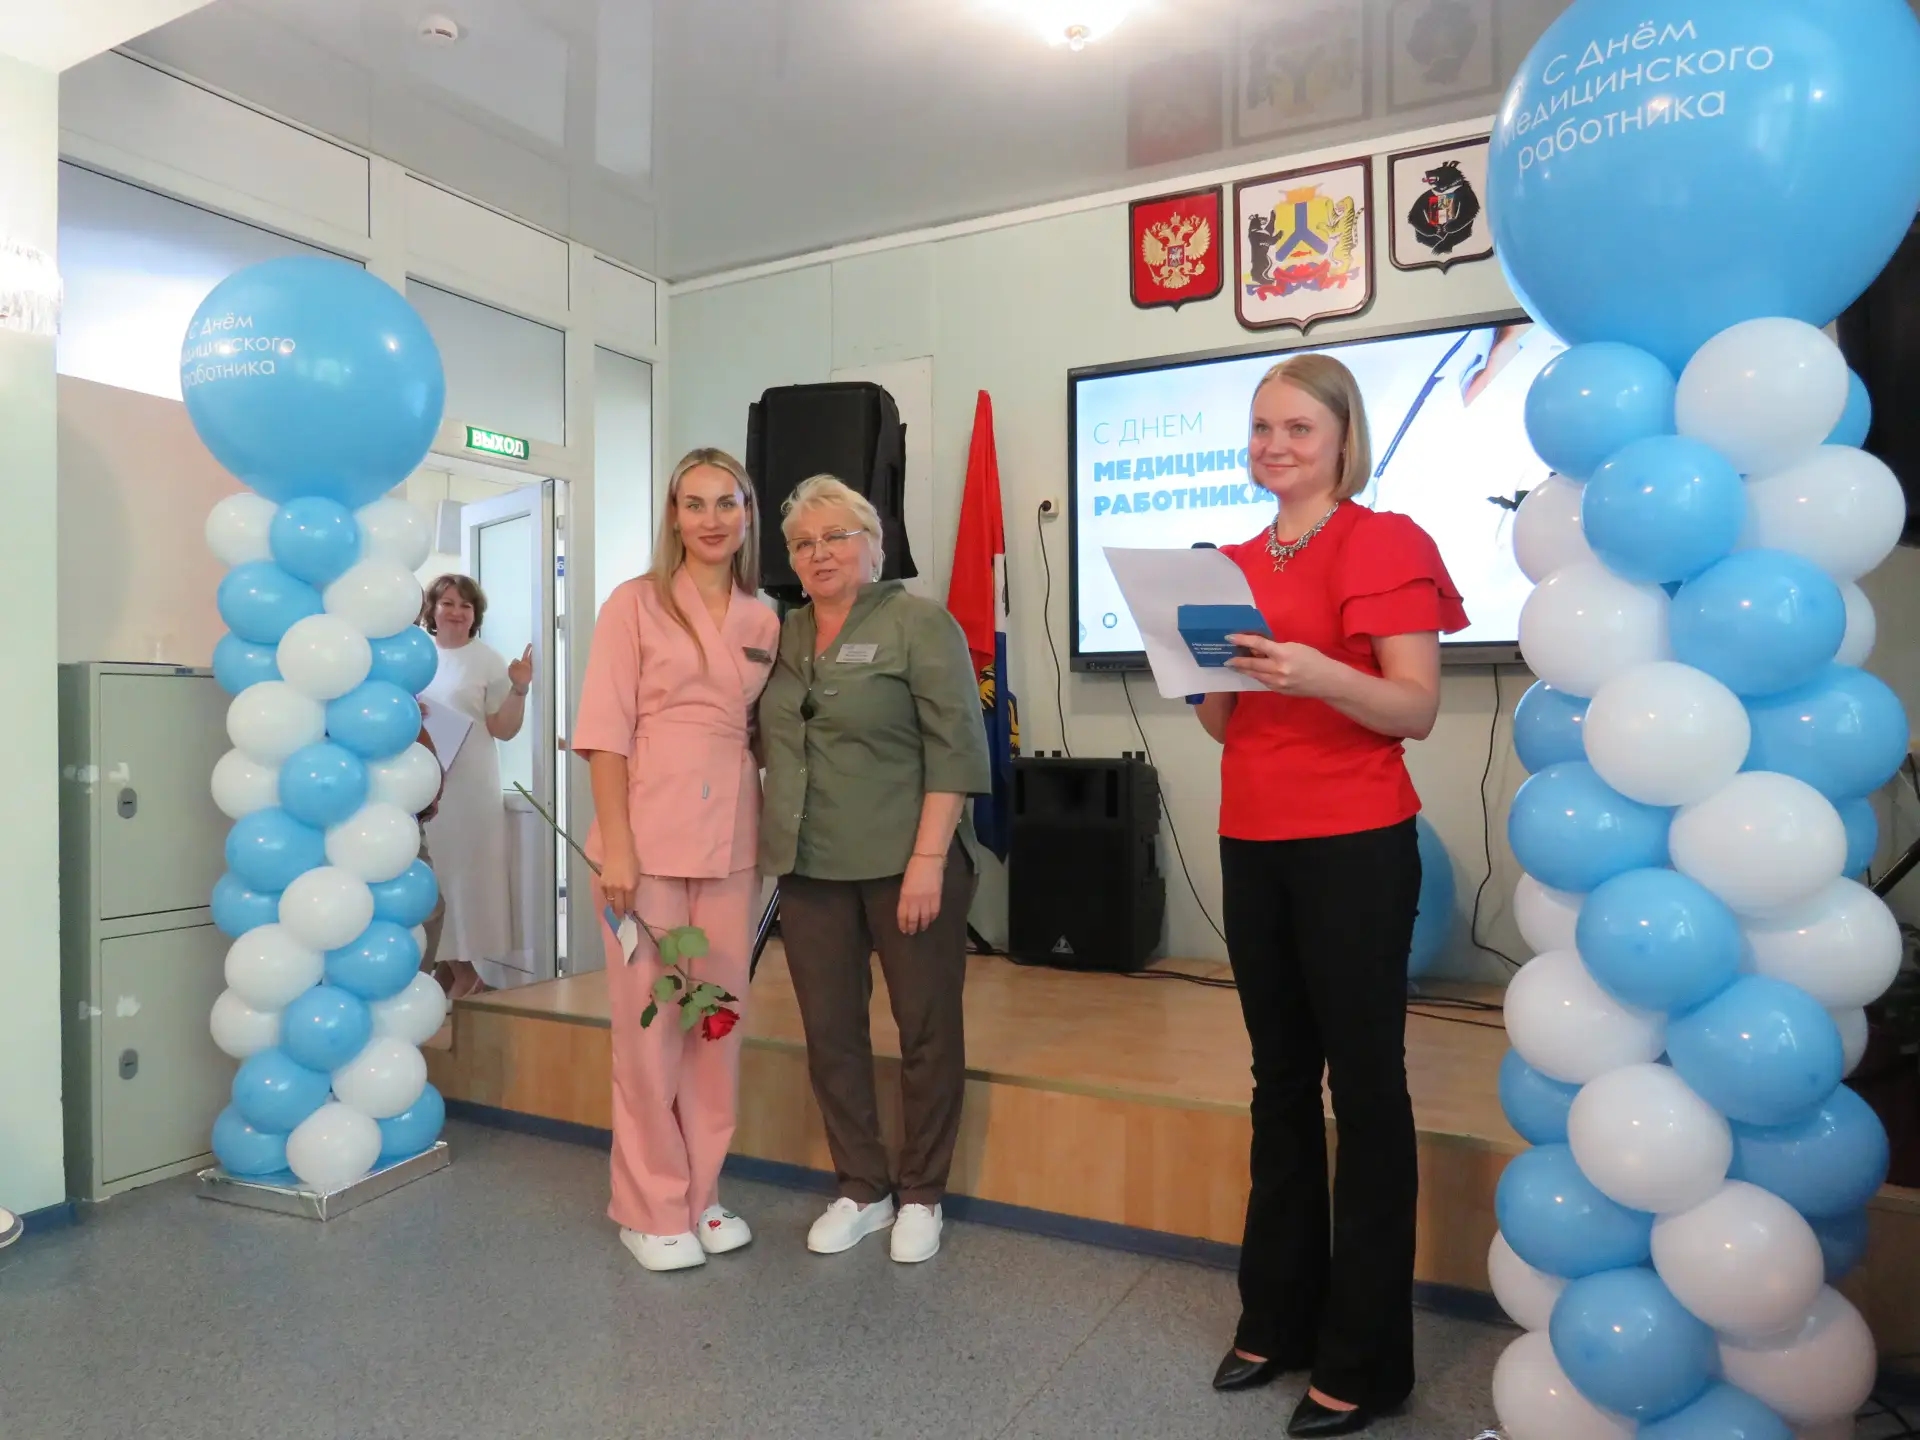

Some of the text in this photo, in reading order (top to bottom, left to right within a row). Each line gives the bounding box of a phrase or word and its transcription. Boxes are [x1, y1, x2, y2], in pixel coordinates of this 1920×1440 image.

[1518, 90, 1726, 176] работника
[472, 429, 524, 458] ВЫХОД
[1093, 411, 1203, 447] С ДНЕМ
[1093, 446, 1249, 482] МЕДИЦИНС
[1093, 484, 1276, 516] РАБОТНИКА
